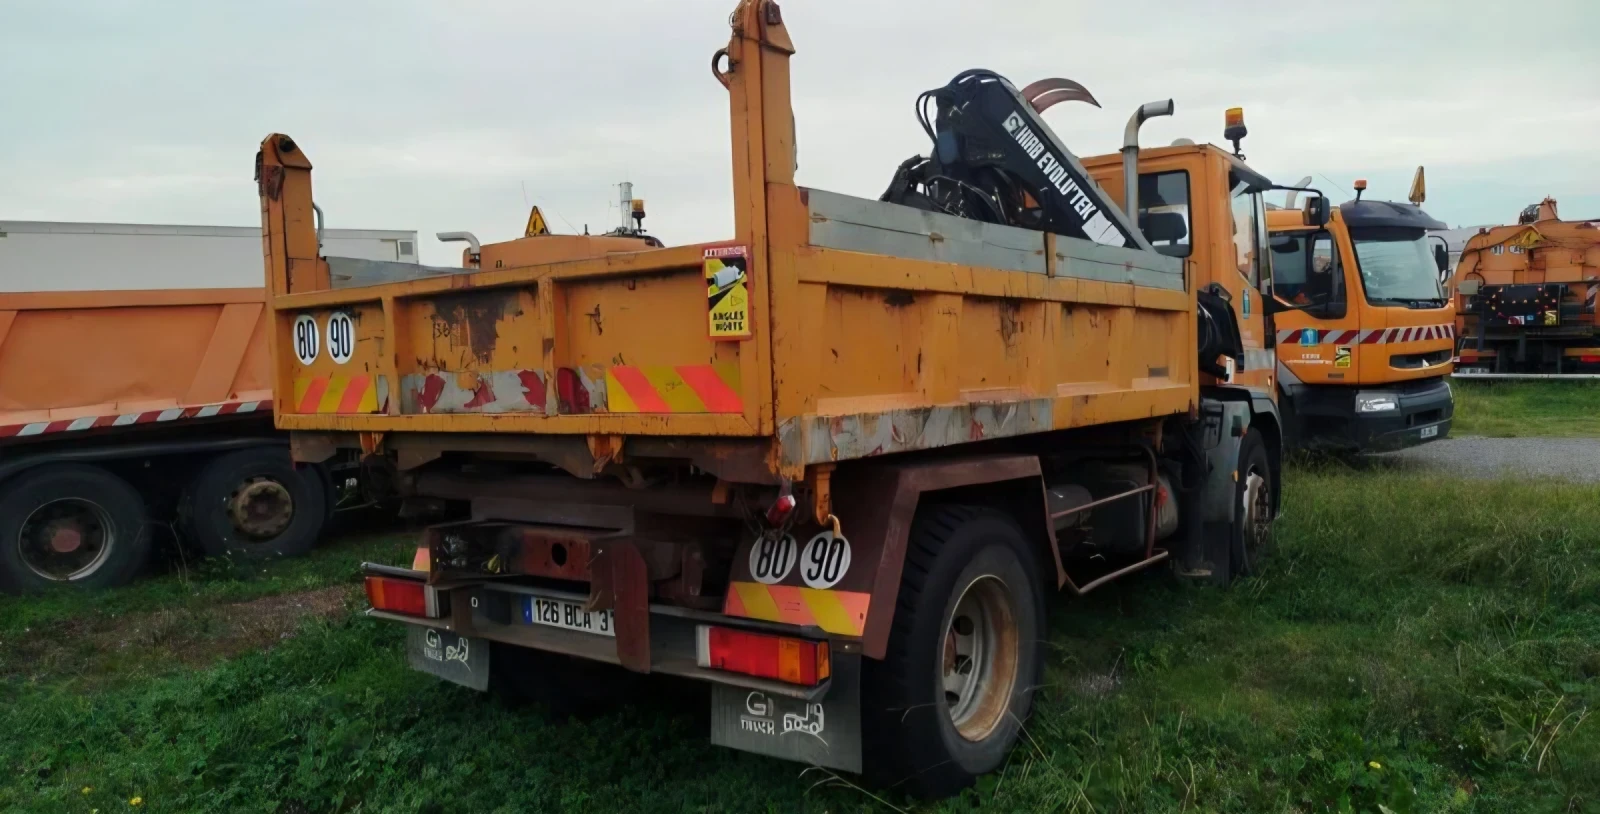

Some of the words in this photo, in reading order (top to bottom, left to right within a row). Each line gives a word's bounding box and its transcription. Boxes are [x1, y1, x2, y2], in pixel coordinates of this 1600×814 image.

[712, 311, 744, 321] ANGLES
[297, 320, 316, 360] 80
[330, 317, 350, 358] 90
[756, 534, 792, 579] 80
[806, 537, 845, 583] 90
[535, 599, 560, 624] 126
[564, 603, 592, 629] BCA
[599, 610, 614, 632] 3
